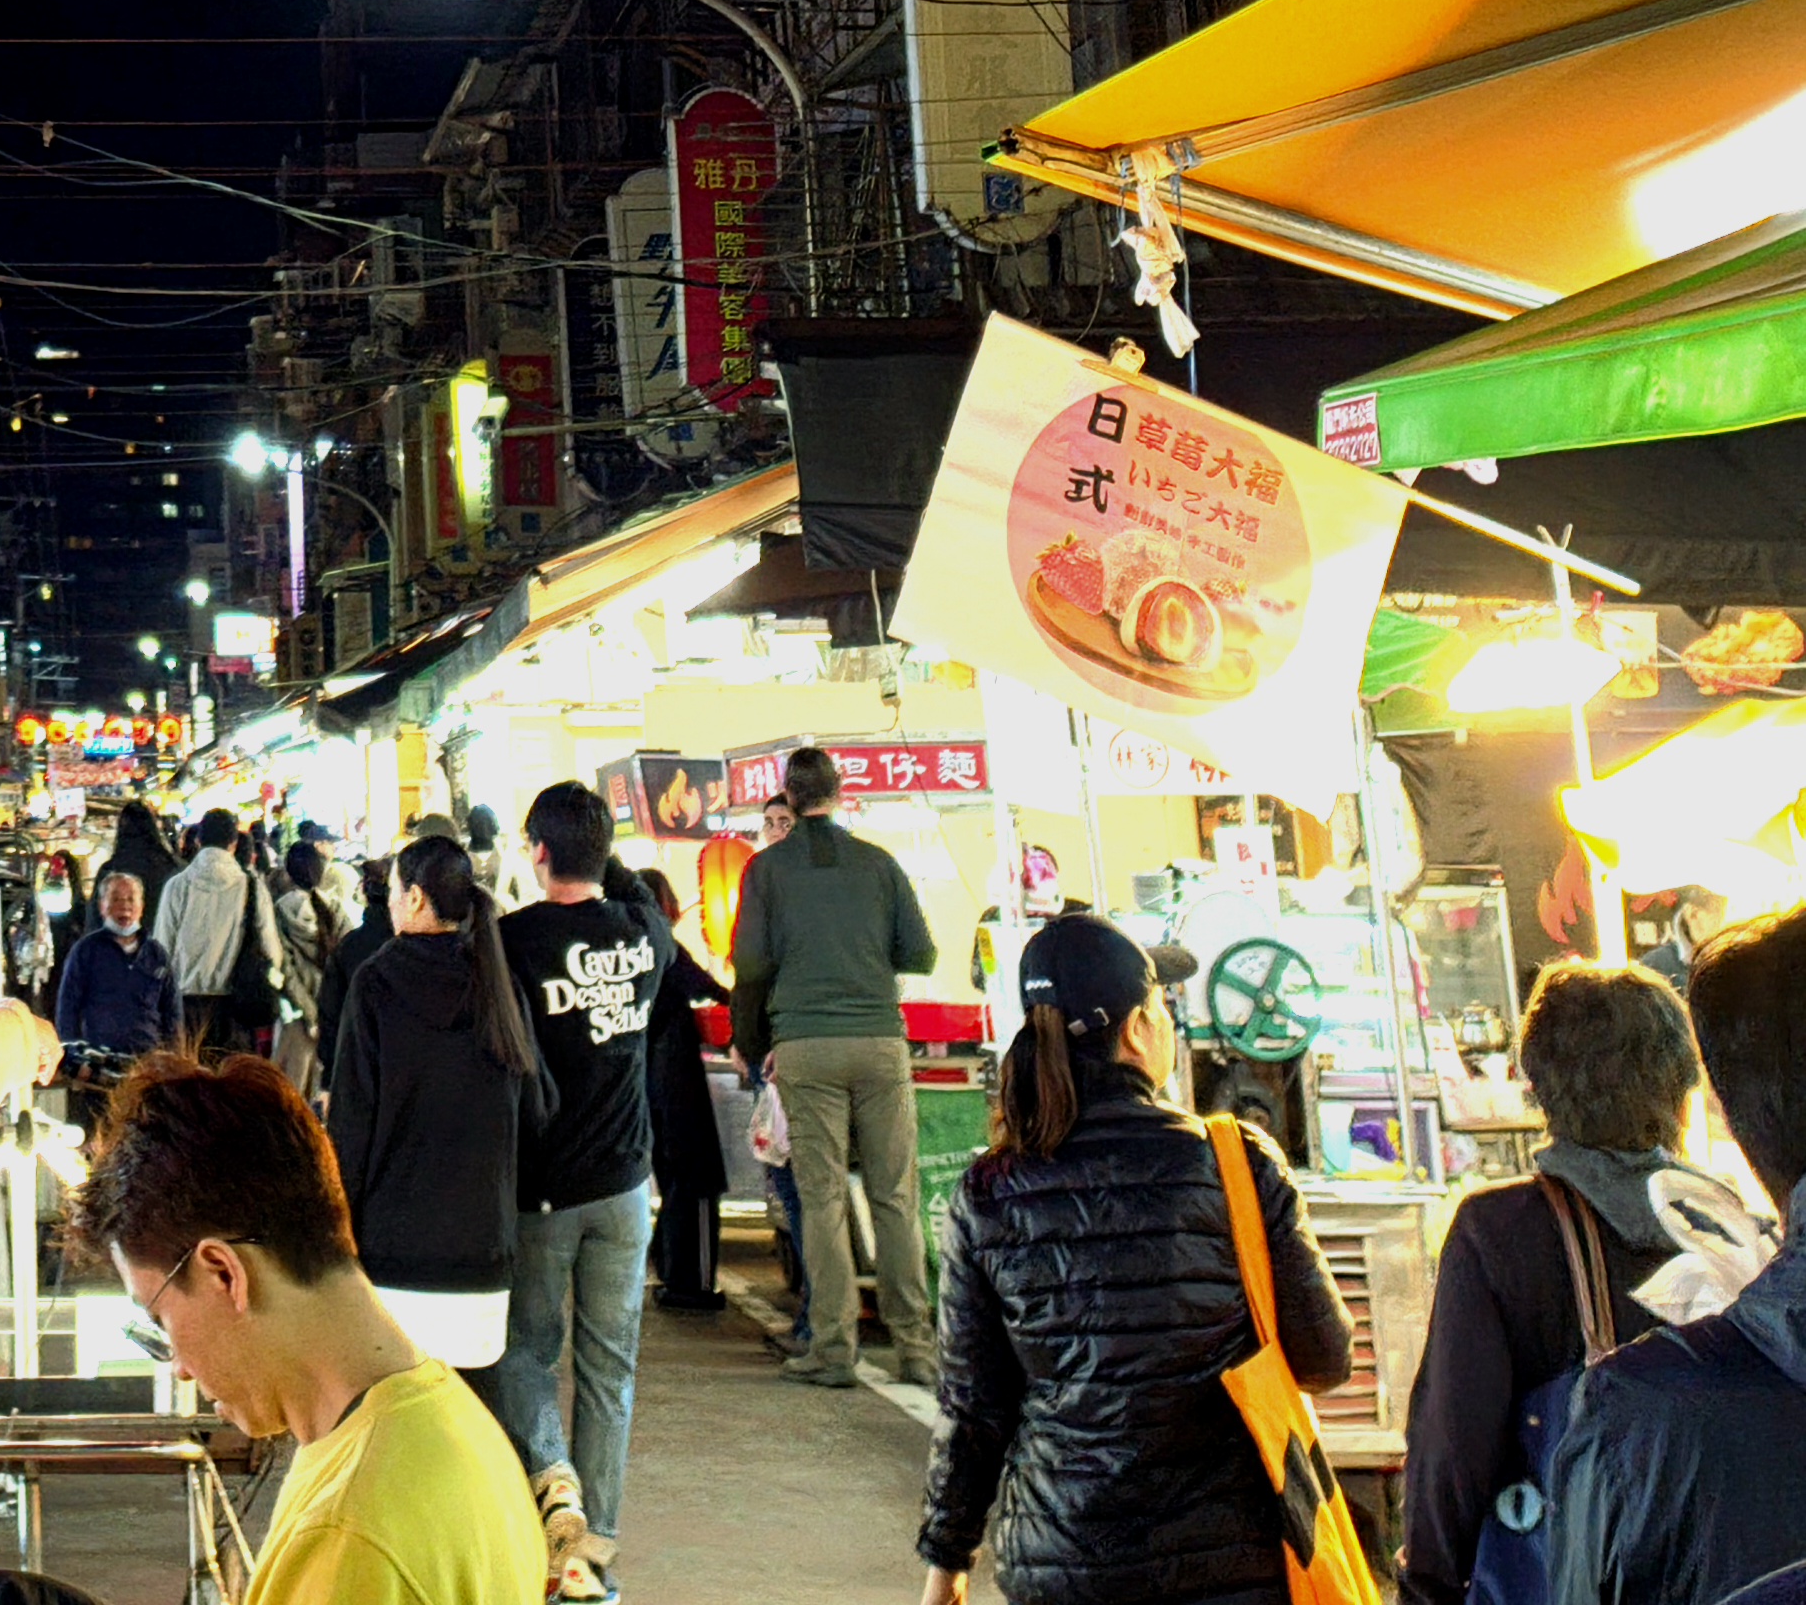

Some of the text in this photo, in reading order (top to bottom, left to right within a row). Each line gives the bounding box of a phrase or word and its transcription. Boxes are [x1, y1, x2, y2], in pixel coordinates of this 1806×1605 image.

[692, 156, 760, 193] 雅丹
[1063, 392, 1129, 515] 日式
[1134, 412, 1285, 506] 草莓大福
[1127, 458, 1262, 543] いちご大福
[566, 935, 655, 986] Cavish
[541, 979, 635, 1016] Design
